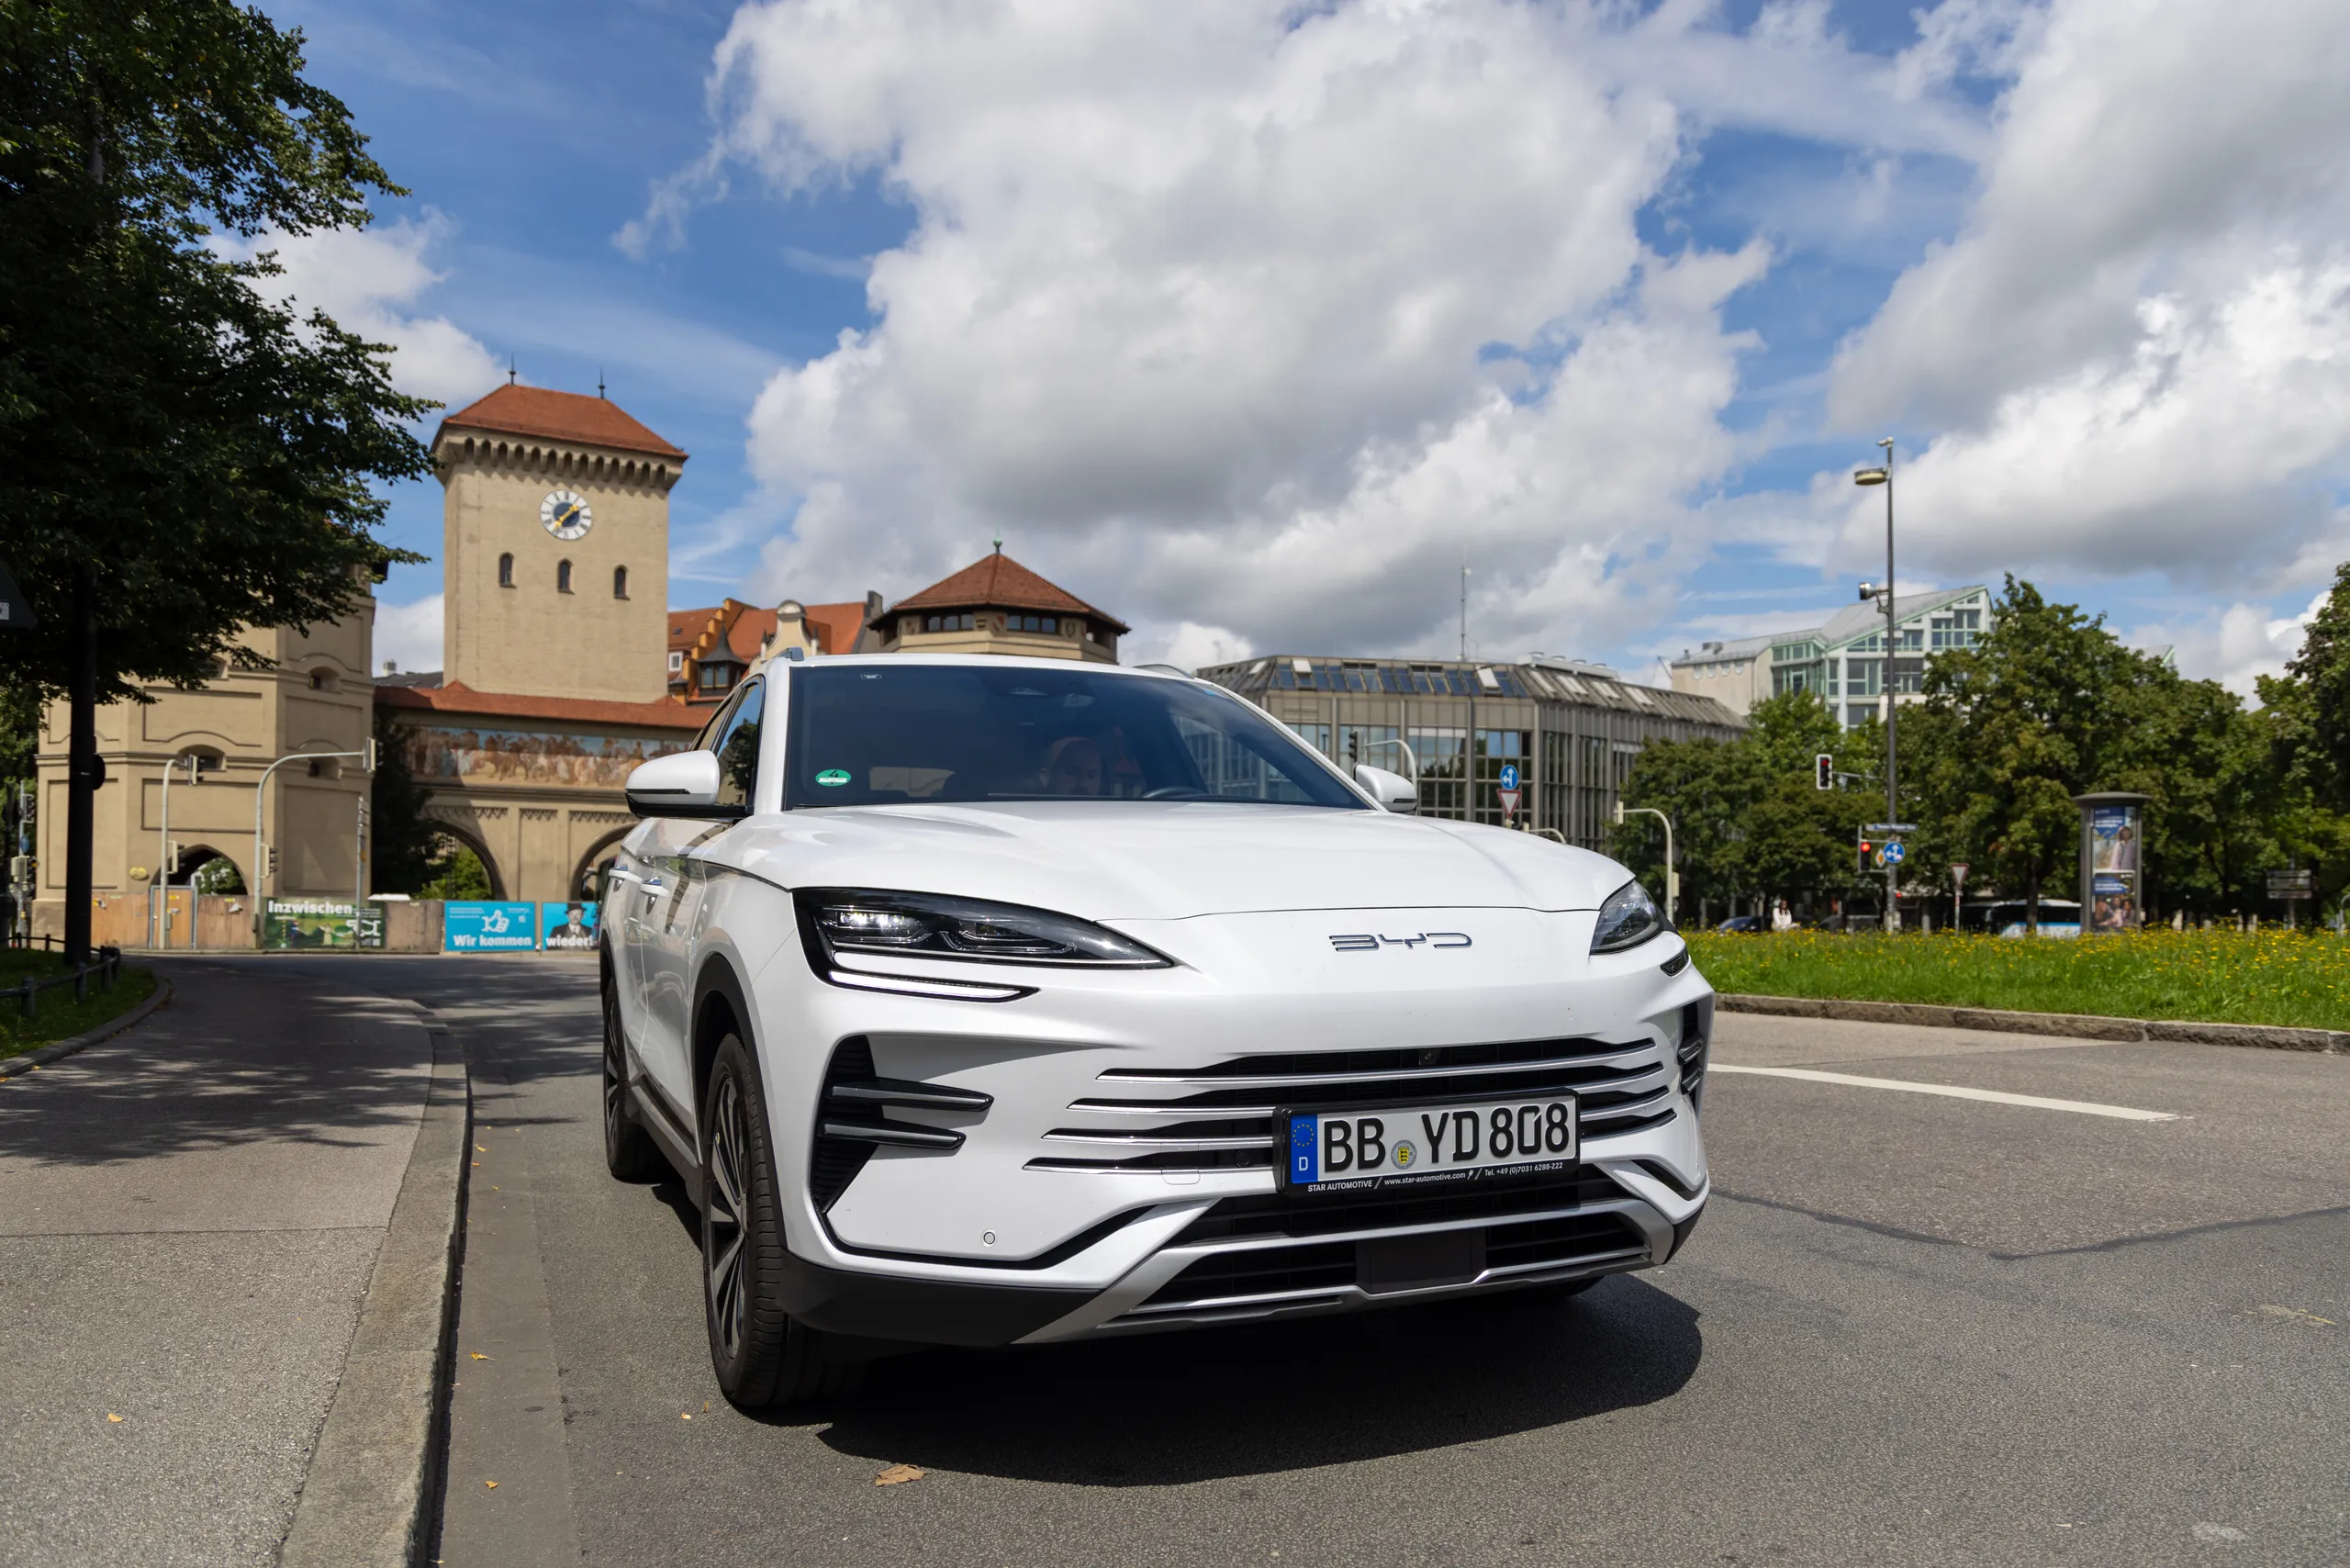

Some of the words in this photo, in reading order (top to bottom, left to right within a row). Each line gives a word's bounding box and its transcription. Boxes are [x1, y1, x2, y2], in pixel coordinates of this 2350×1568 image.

[829, 769, 839, 778] 4
[268, 900, 353, 914] Inzwischen
[453, 935, 476, 946] Wir
[479, 935, 532, 946] kommen
[545, 935, 594, 946] wieder!
[1328, 933, 1472, 952] BYD
[1324, 1117, 1386, 1172] BB
[1421, 1110, 1480, 1163] YD
[1489, 1103, 1570, 1159] 808
[1298, 1156, 1309, 1171] D
[1308, 1183, 1326, 1193] STAR
[1327, 1180, 1372, 1191] AUTOMOTIVE
[1384, 1171, 1466, 1185] www.star-automotive.com
[1484, 1169, 1495, 1177] Tel.
[1496, 1167, 1508, 1175] +49
[1509, 1164, 1533, 1175] (0)7031
[1534, 1161, 1563, 1171] 6288-222
